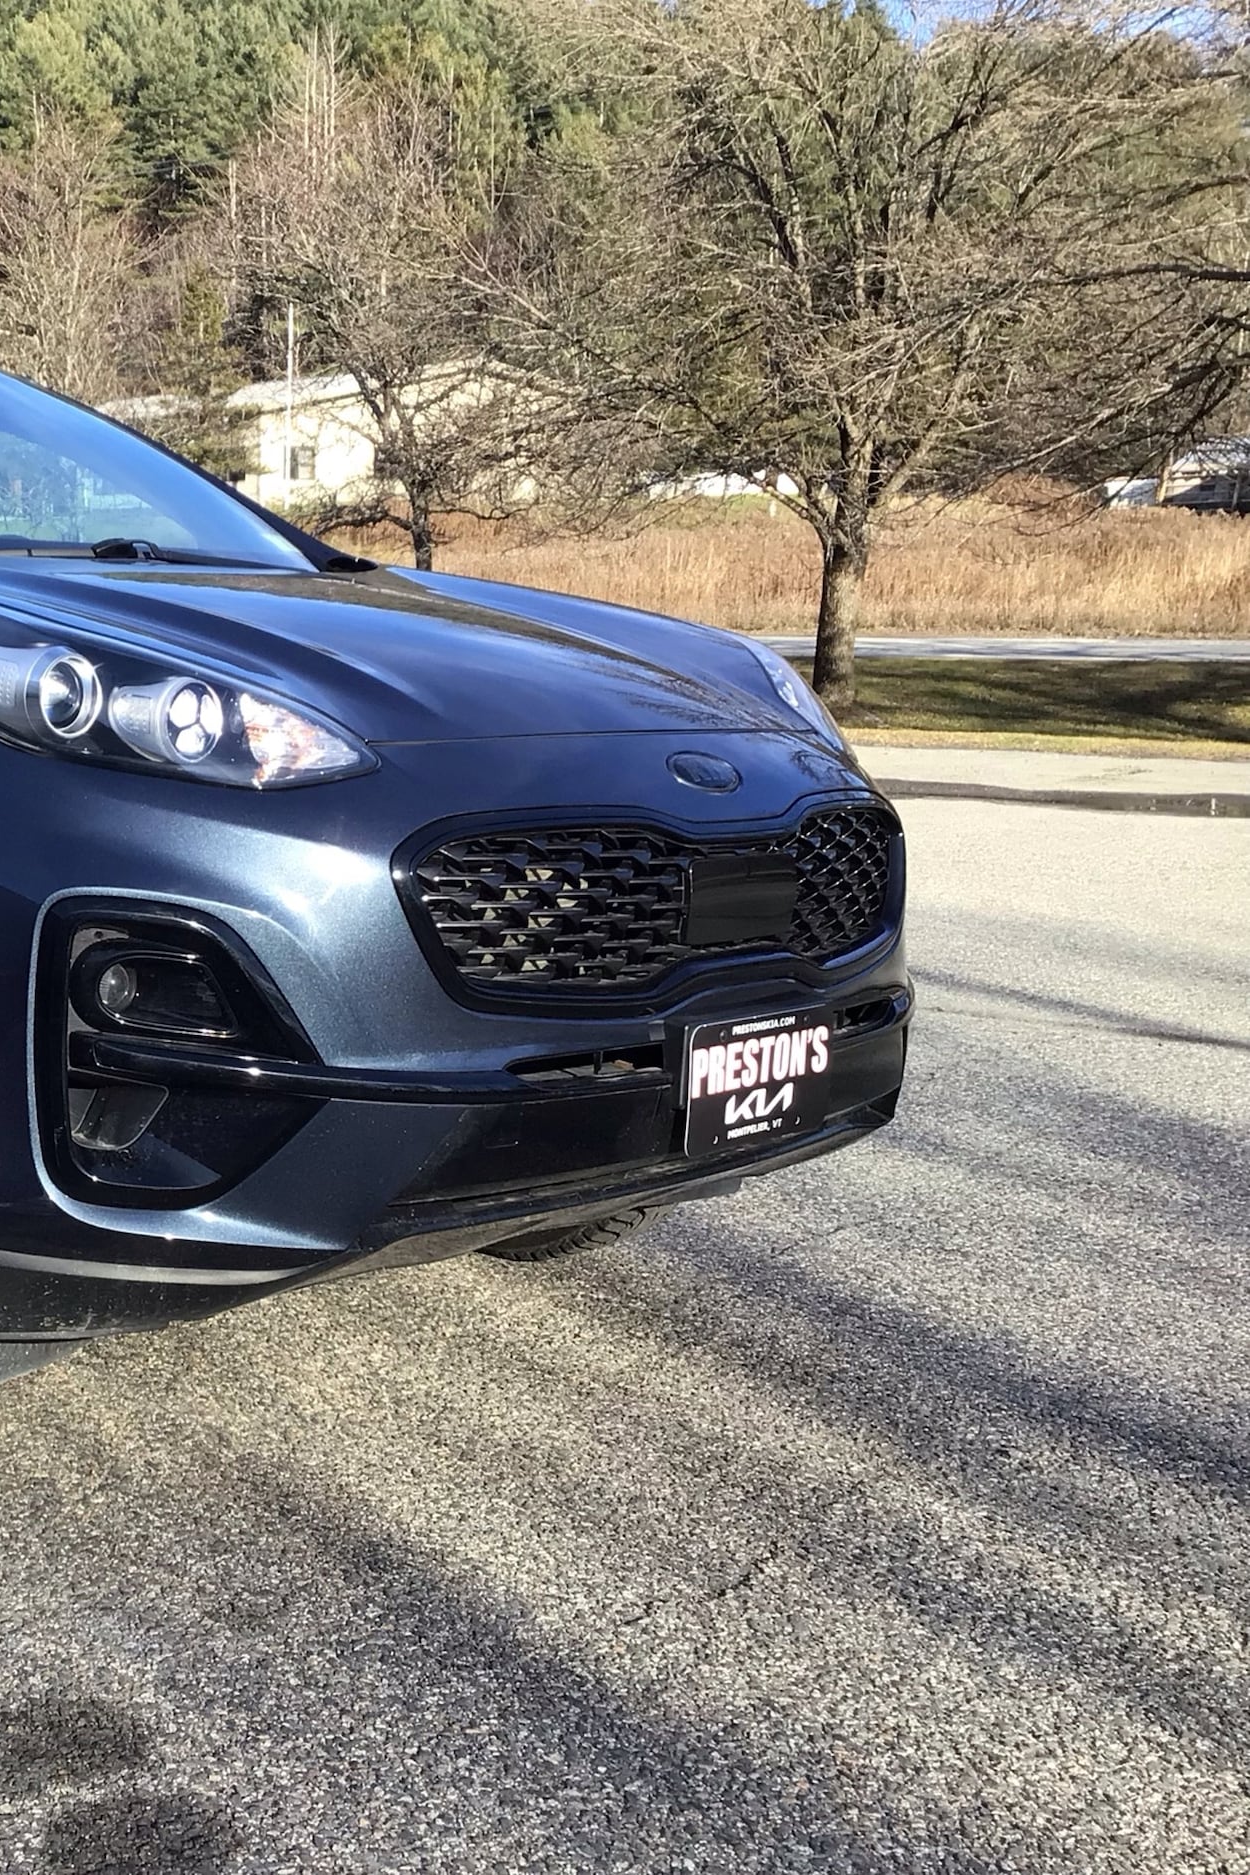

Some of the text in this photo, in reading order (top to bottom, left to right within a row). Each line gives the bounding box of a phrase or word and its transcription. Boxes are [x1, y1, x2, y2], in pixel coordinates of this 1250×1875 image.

[732, 1016, 796, 1036] PRESTONSKIA.COM
[691, 1025, 829, 1099] PRESTON'S
[727, 1118, 783, 1140] MONTPELIER, VT
